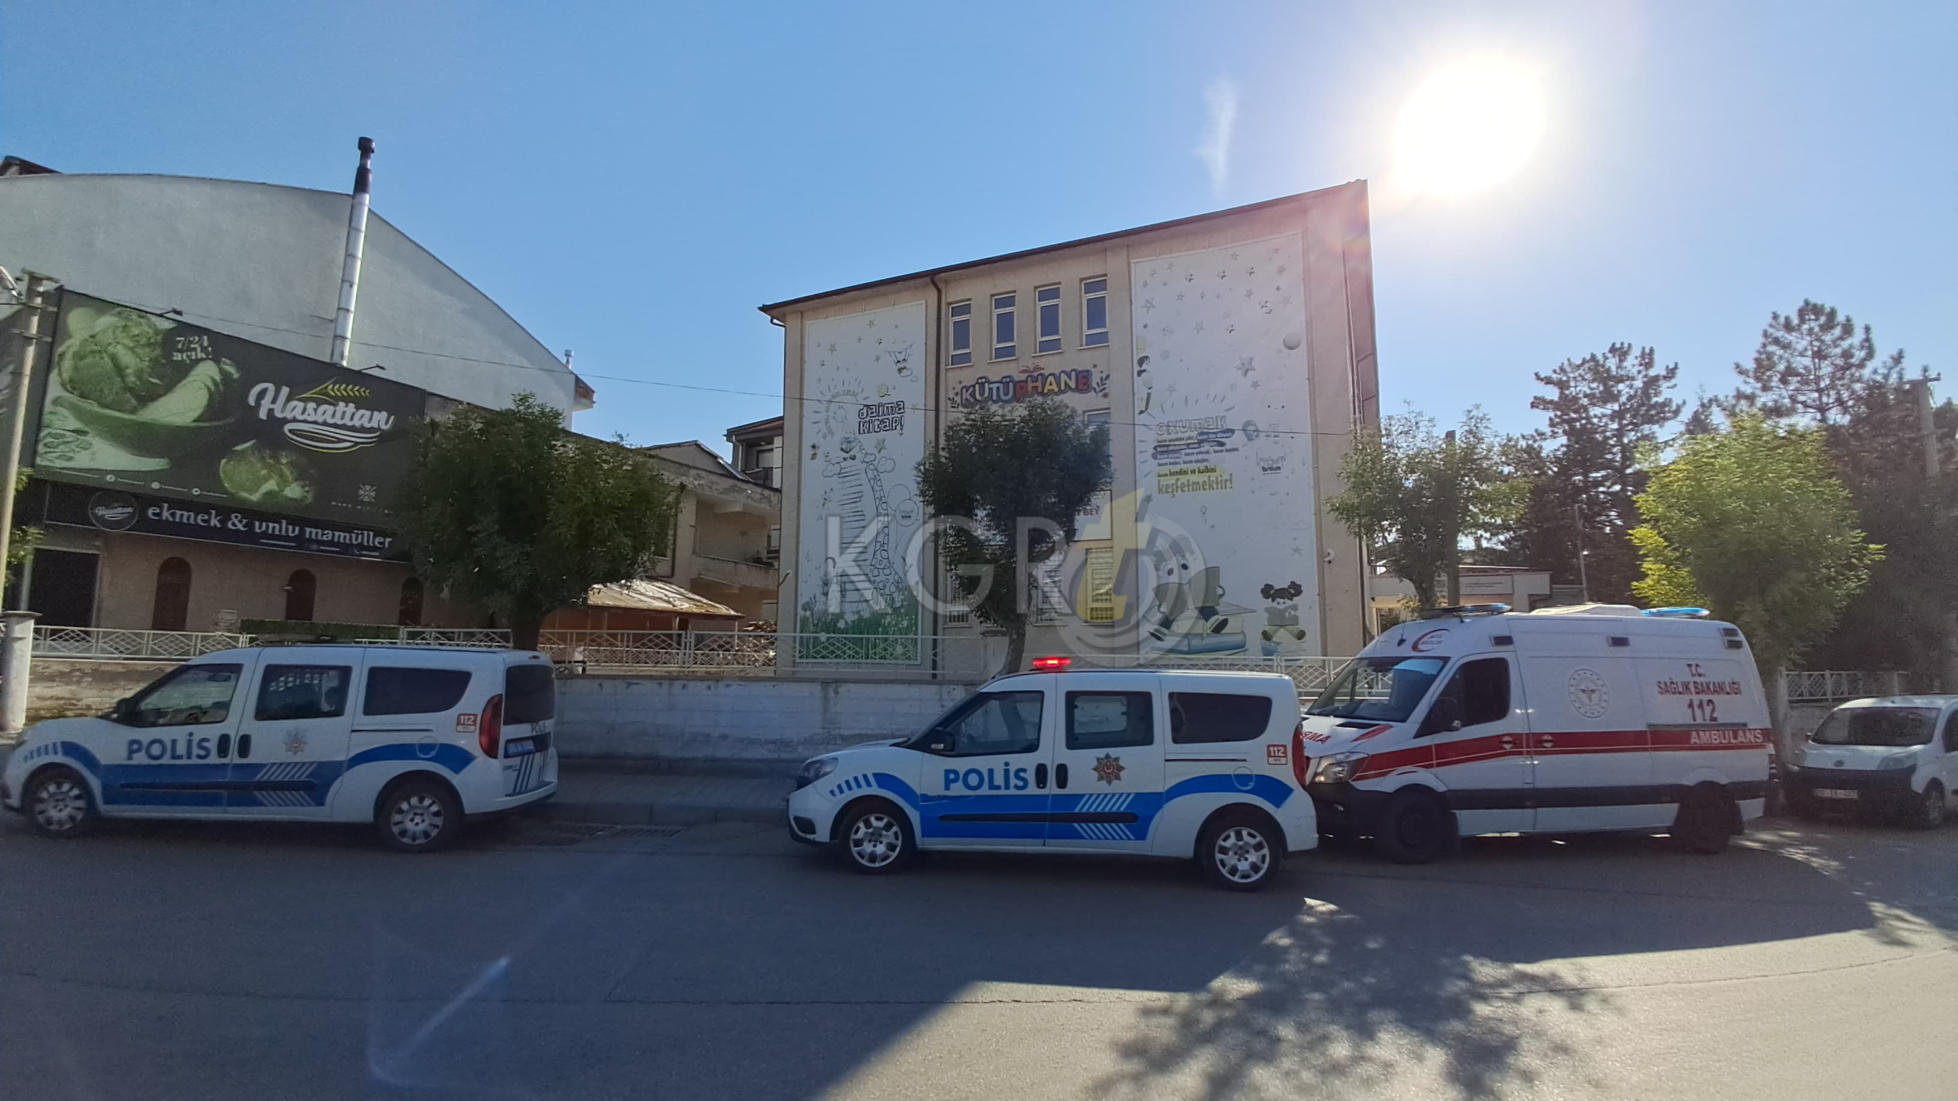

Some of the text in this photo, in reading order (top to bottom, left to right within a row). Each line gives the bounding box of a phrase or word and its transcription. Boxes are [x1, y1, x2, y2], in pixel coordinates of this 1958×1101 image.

[175, 335, 208, 350] 7/24
[961, 368, 1093, 406] KÜTÜPHANE
[247, 382, 395, 430] Hasattan
[1157, 472, 1233, 496] keşfetmektir!
[147, 502, 223, 528] ekmek
[228, 512, 248, 531] &
[304, 526, 392, 548] mamüller
[1686, 663, 1706, 678] T.C.
[1656, 677, 1742, 695] SAĞLIK BAKANLIĞI
[460, 715, 474, 725] 112
[1688, 698, 1718, 722] 112
[127, 731, 212, 761] POLİS
[1690, 729, 1763, 745] AMBULANS
[1269, 746, 1286, 757] 112
[943, 761, 1029, 791] POLİS
